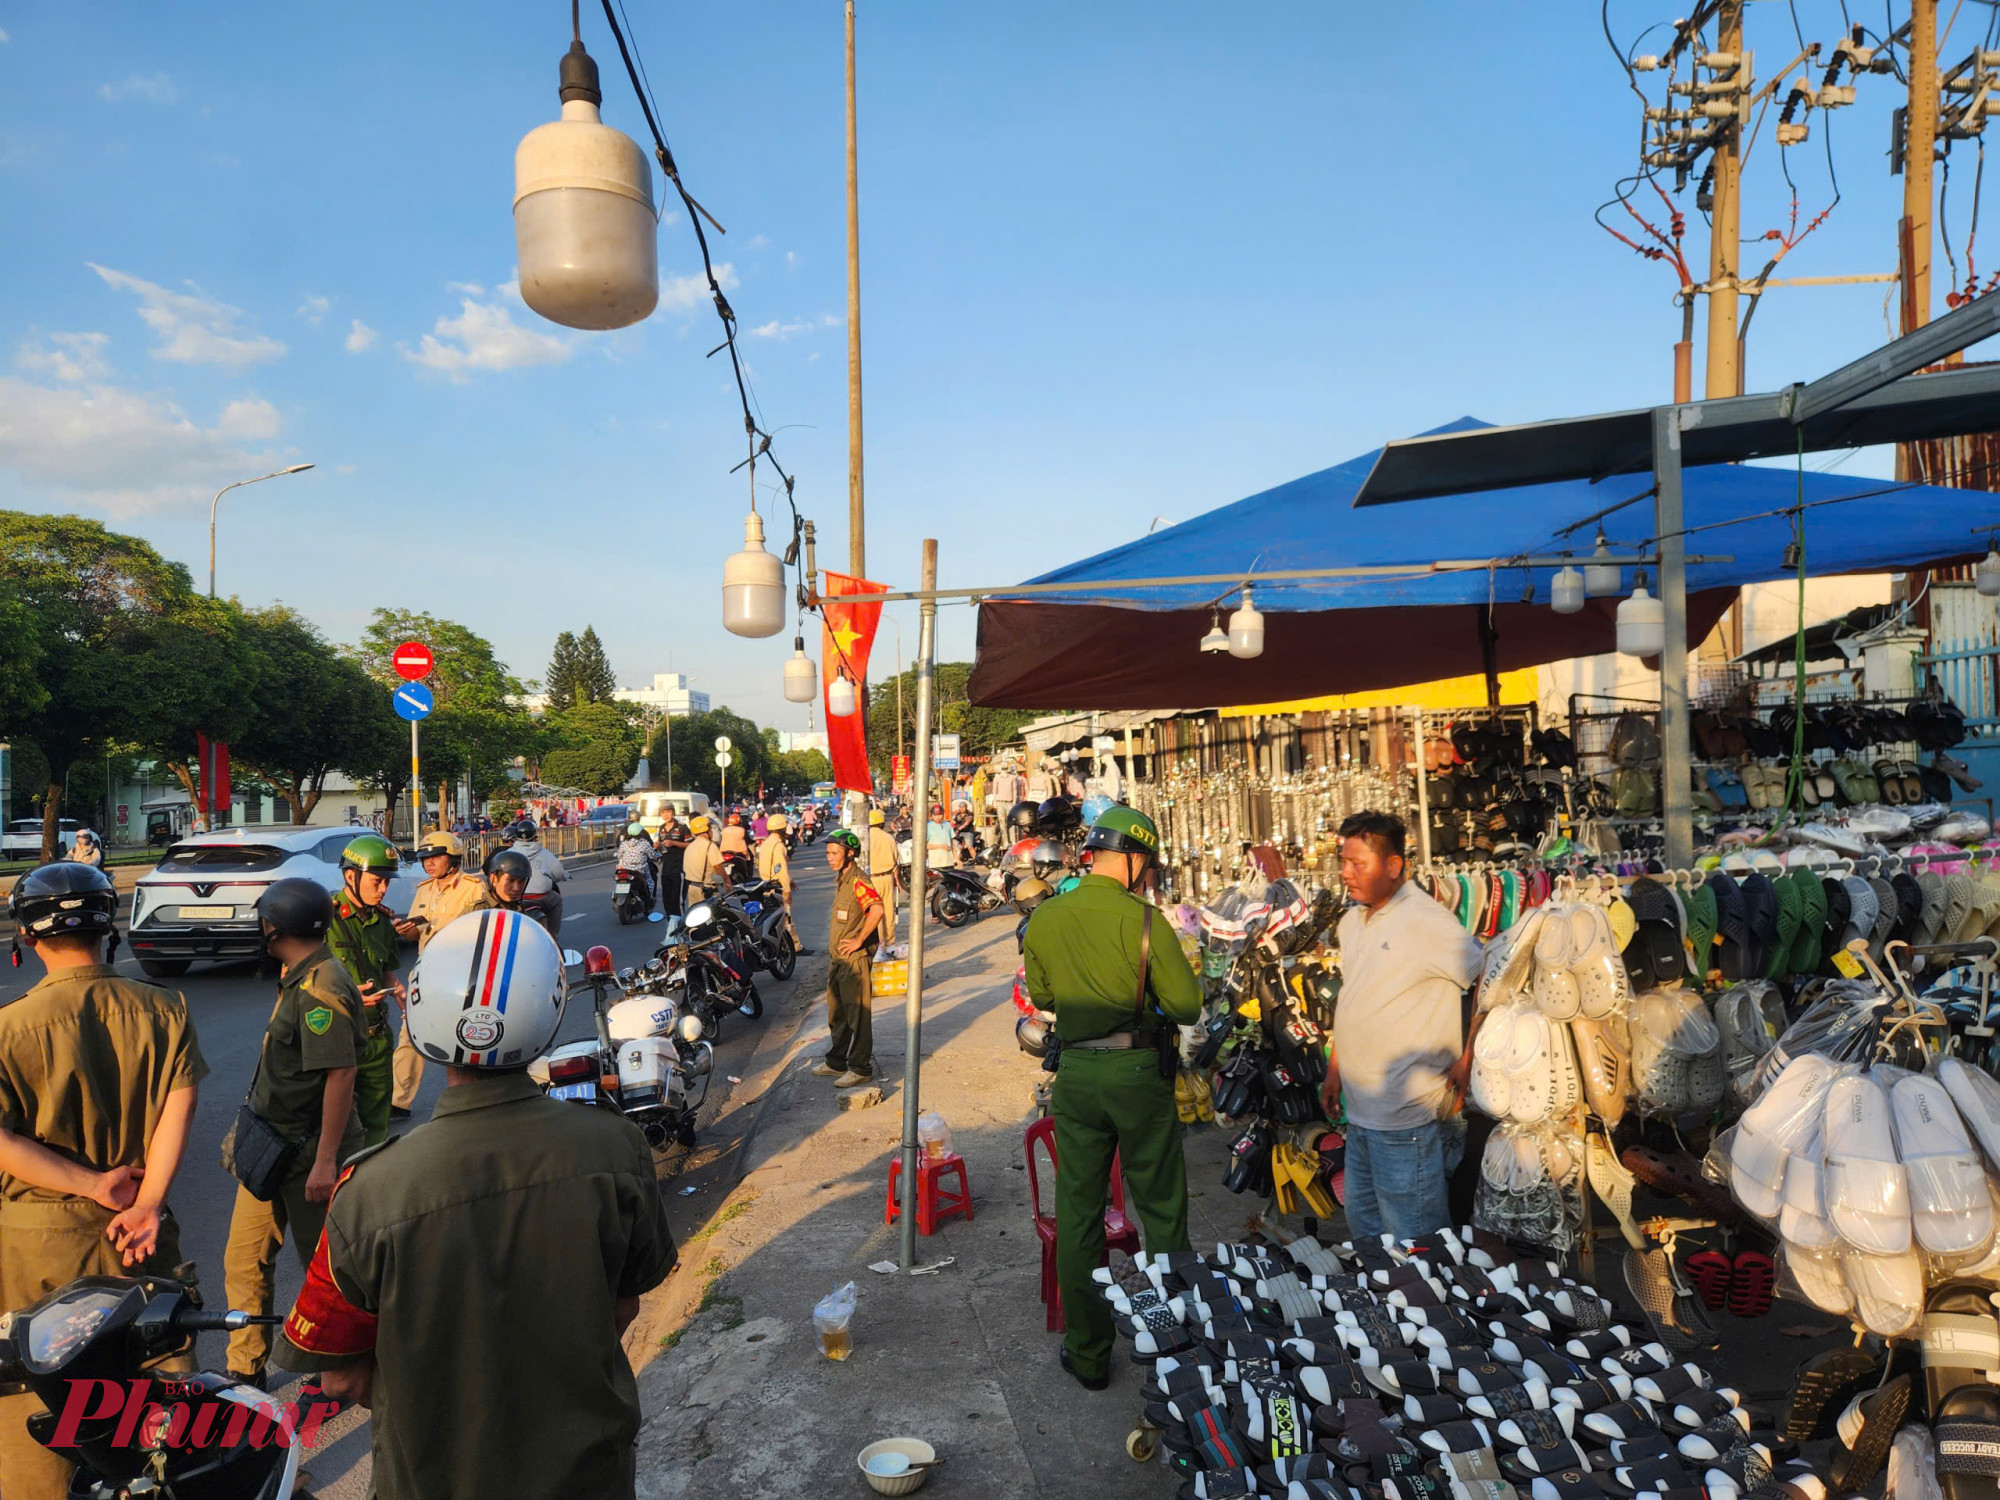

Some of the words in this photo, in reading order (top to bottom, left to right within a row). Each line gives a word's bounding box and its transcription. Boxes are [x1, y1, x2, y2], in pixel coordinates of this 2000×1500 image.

[1130, 824, 1156, 846] CSTT
[1544, 1068, 1559, 1114] Sport
[1565, 1065, 1577, 1108] Sport
[1918, 1094, 1931, 1124] DUWA
[1942, 1443, 1976, 1453] SUCCESS
